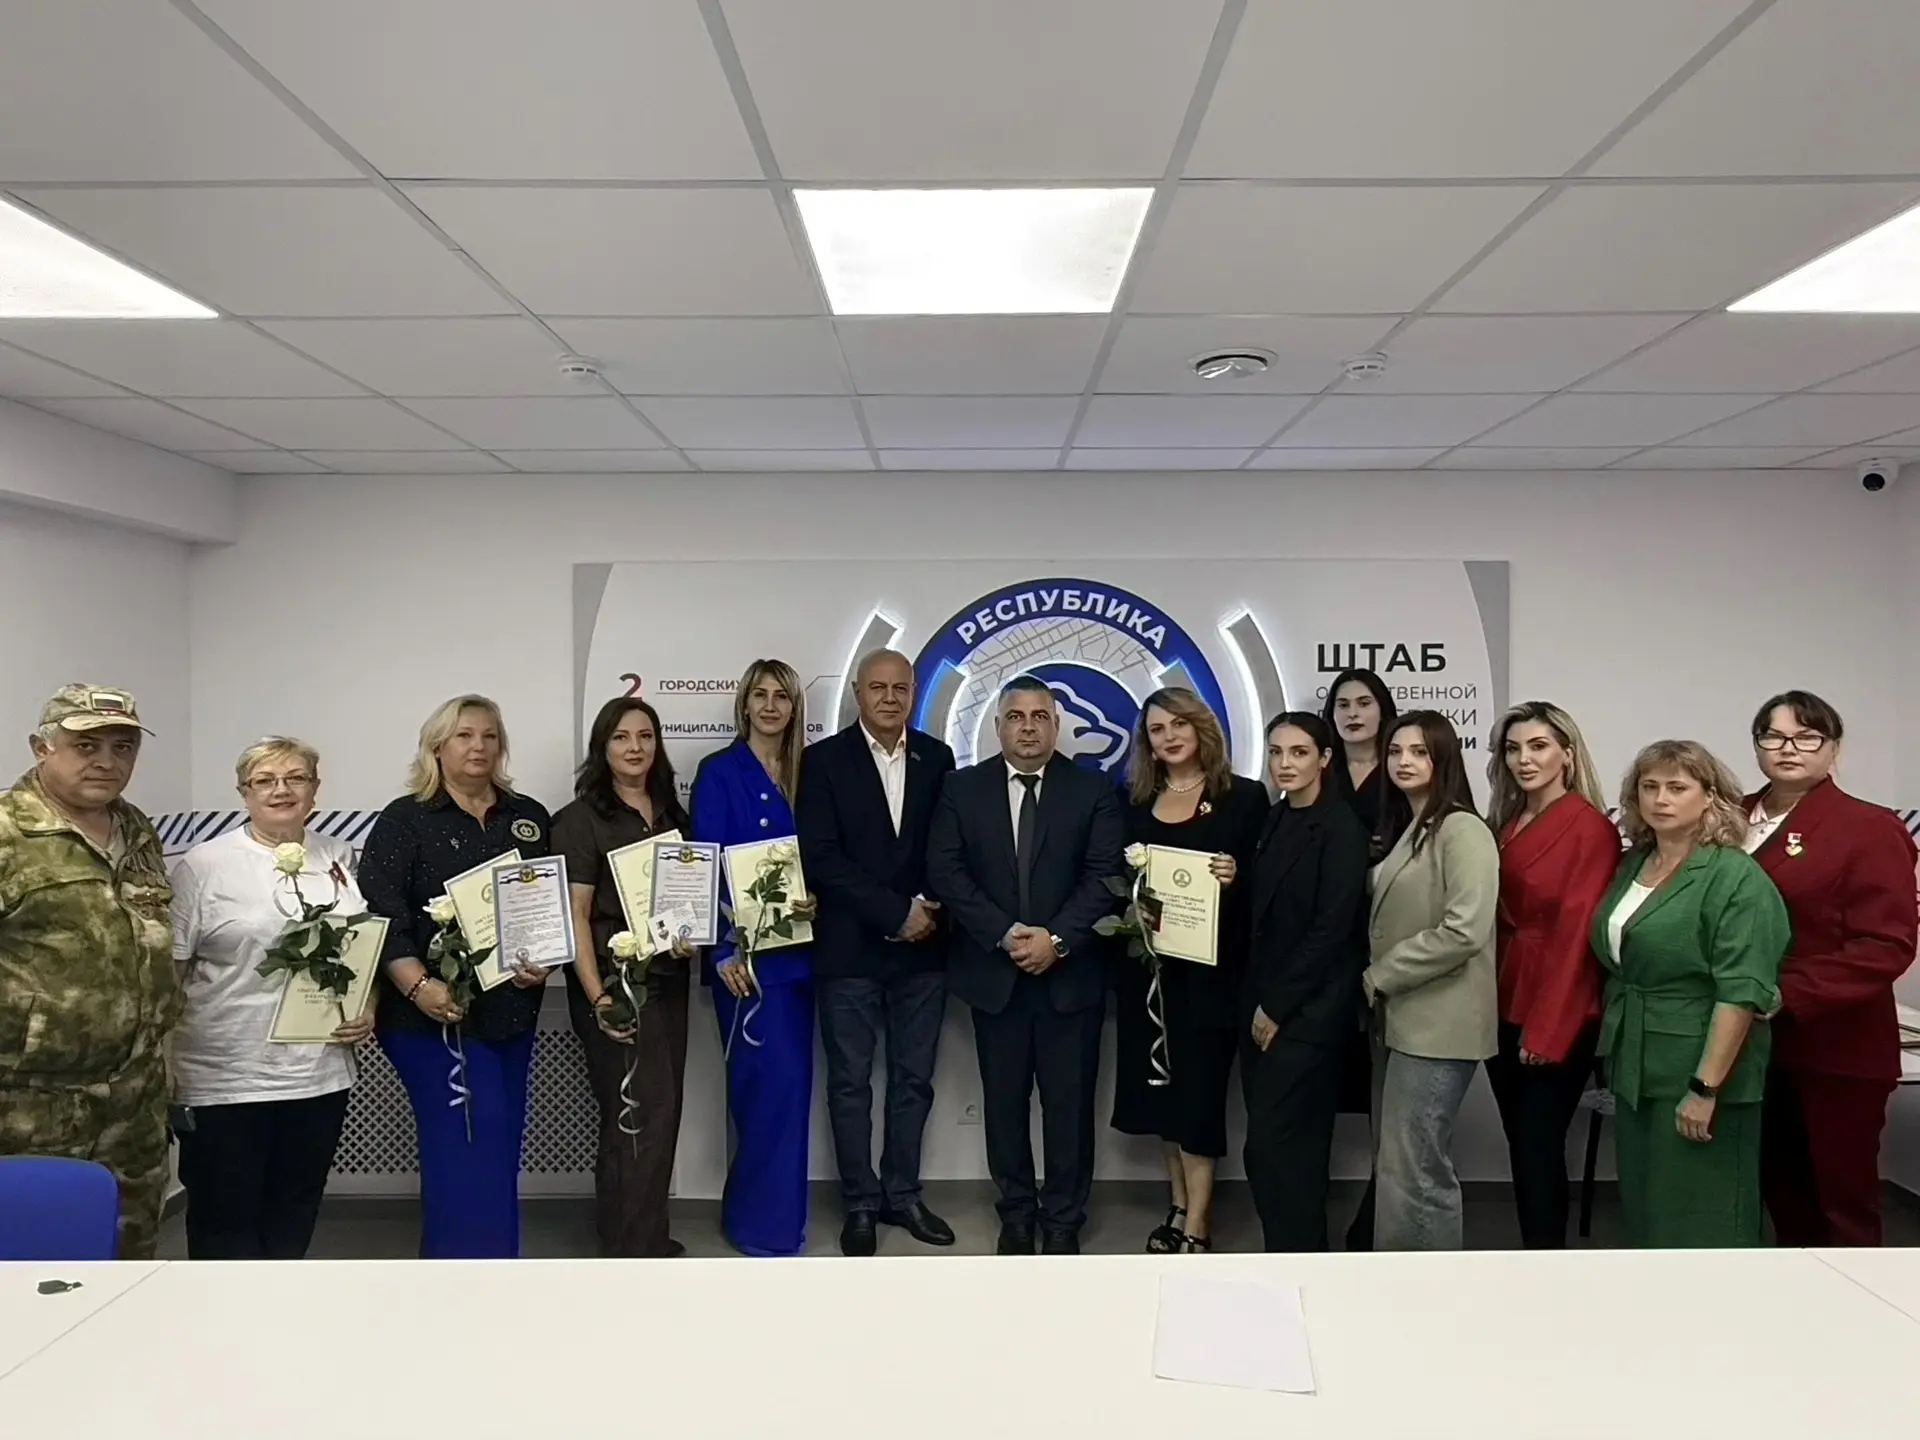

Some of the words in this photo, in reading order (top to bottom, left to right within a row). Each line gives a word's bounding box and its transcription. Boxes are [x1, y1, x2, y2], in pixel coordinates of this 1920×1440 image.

[955, 588, 1167, 650] РЕСПУБЛИКА
[1317, 643, 1446, 672] ШТАБ
[619, 673, 643, 700] 2
